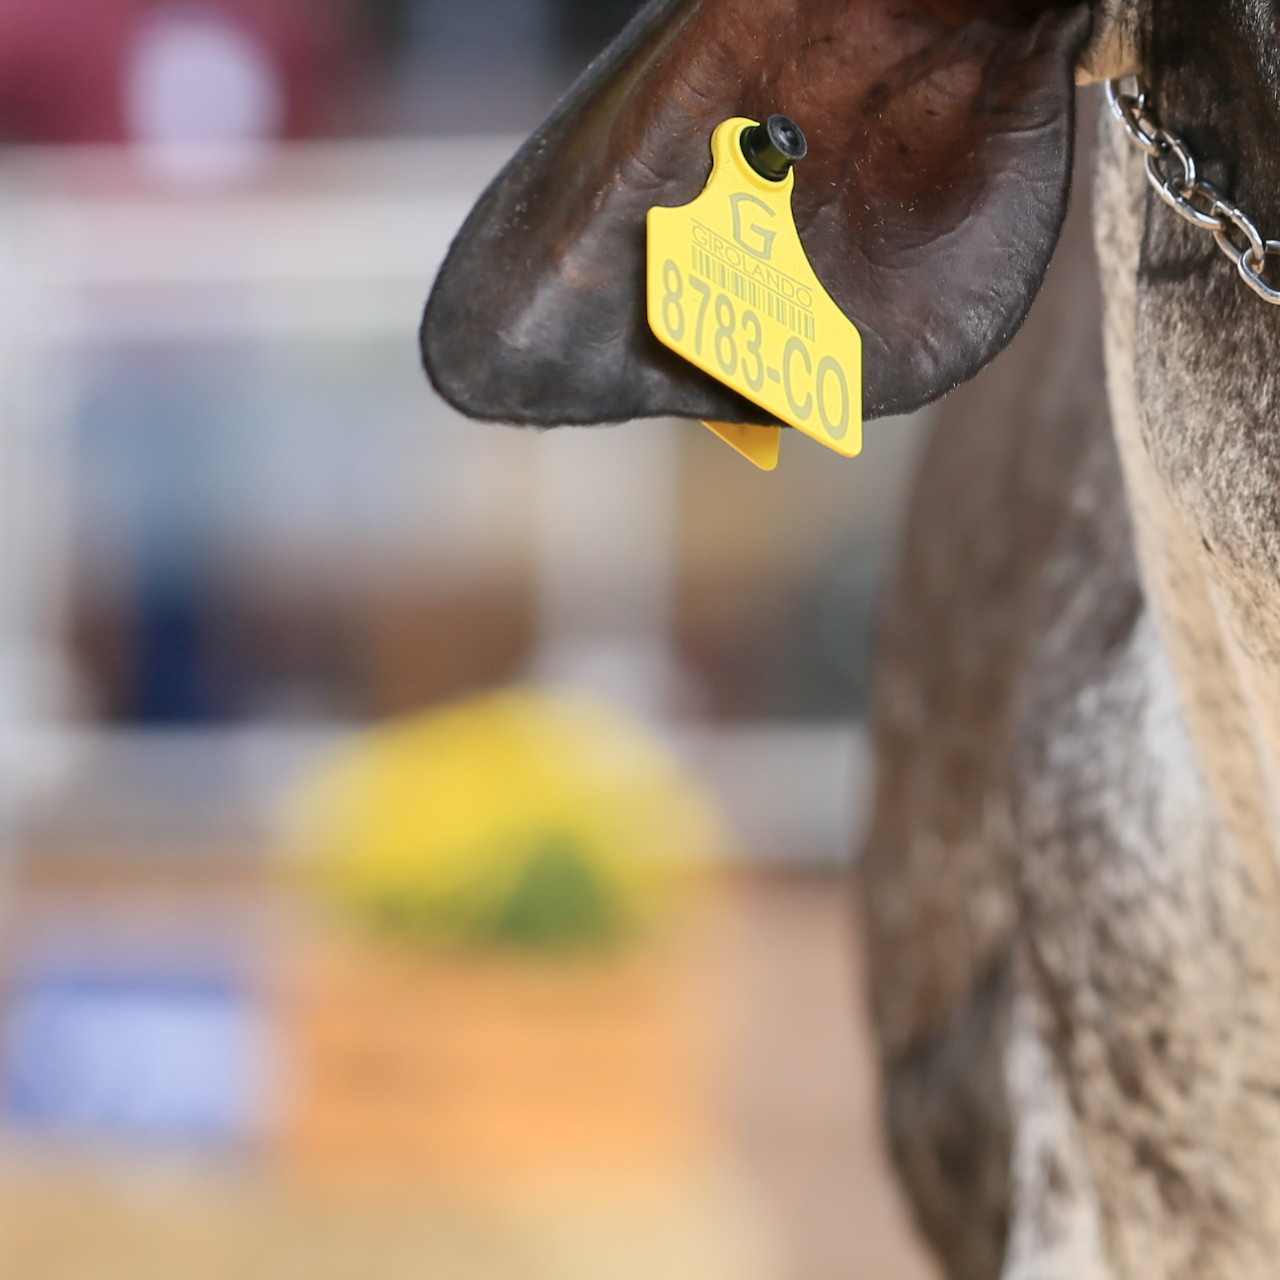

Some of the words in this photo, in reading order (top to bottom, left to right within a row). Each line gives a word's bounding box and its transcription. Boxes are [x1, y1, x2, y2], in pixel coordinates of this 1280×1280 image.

[691, 224, 814, 310] GIROLANDO
[729, 192, 777, 260] G
[662, 259, 849, 440] 8783-CO
